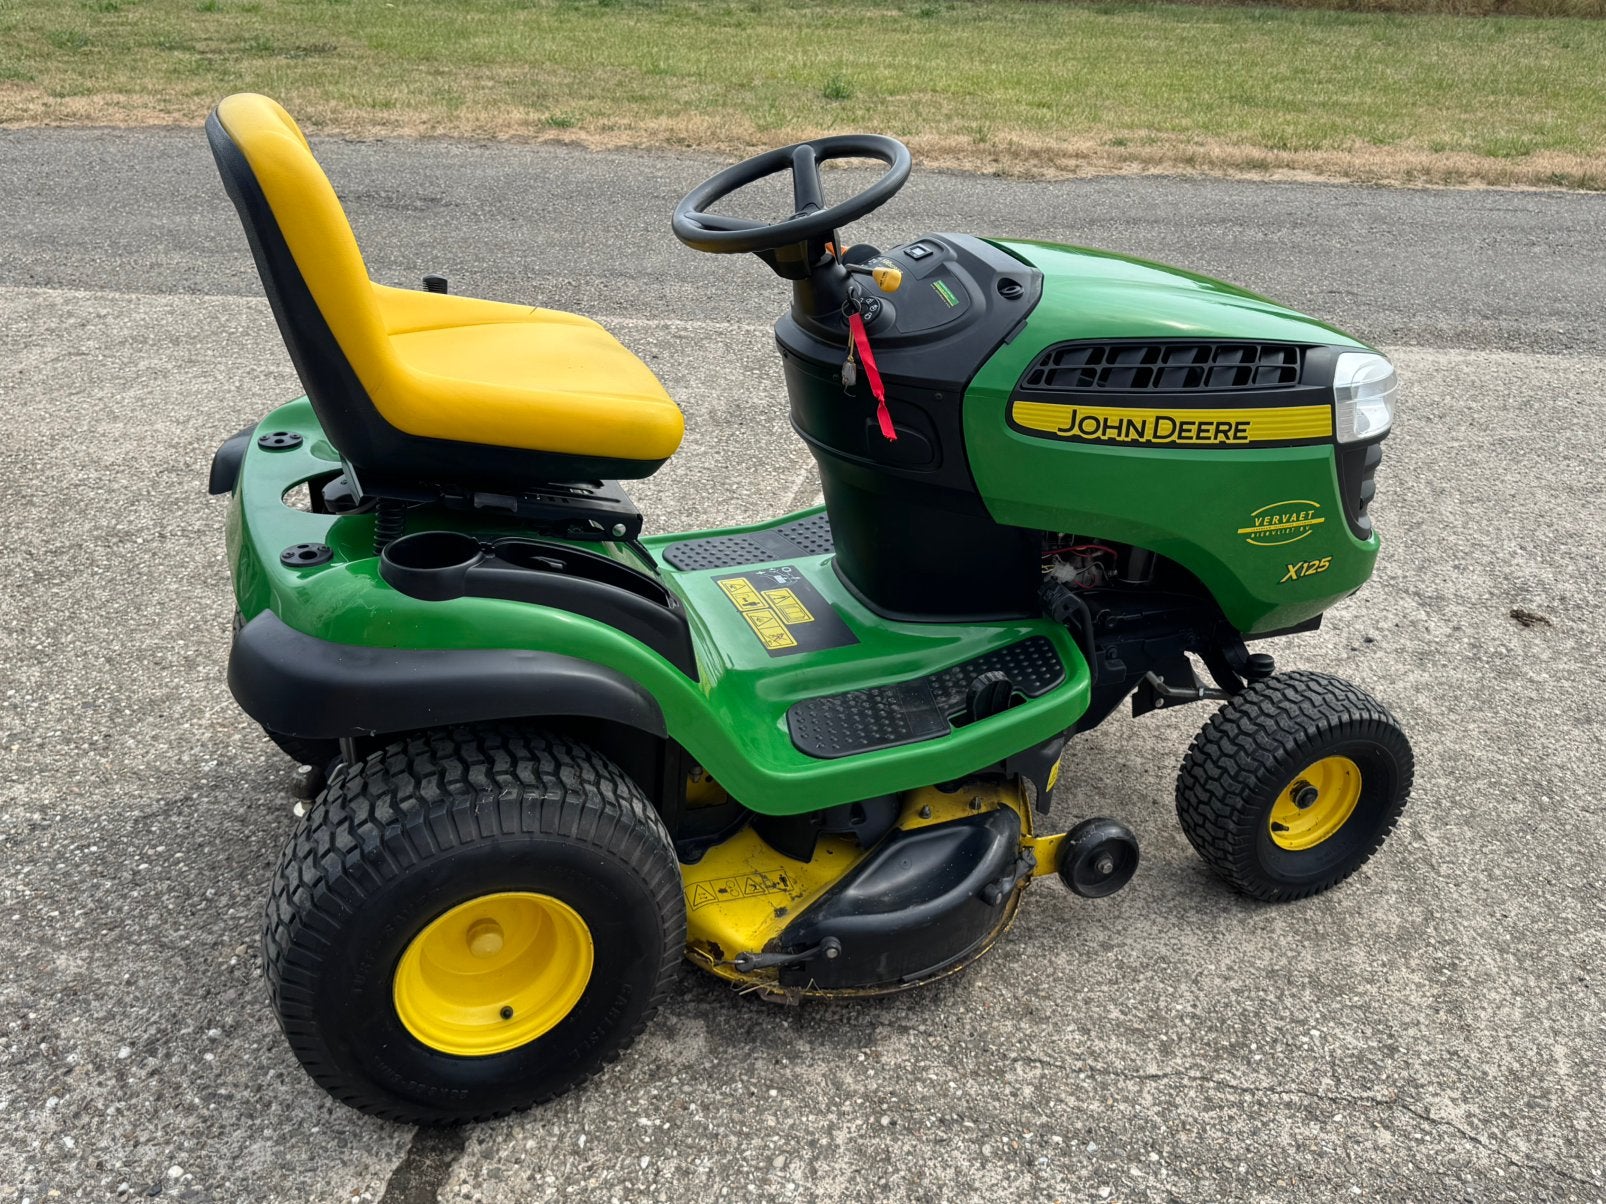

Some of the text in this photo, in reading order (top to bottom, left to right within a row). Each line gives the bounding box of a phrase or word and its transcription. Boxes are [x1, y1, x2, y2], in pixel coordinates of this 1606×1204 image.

[1057, 409, 1251, 441] JOHN DEERE
[1254, 510, 1315, 527] VERVAET
[1279, 556, 1333, 583] X125
